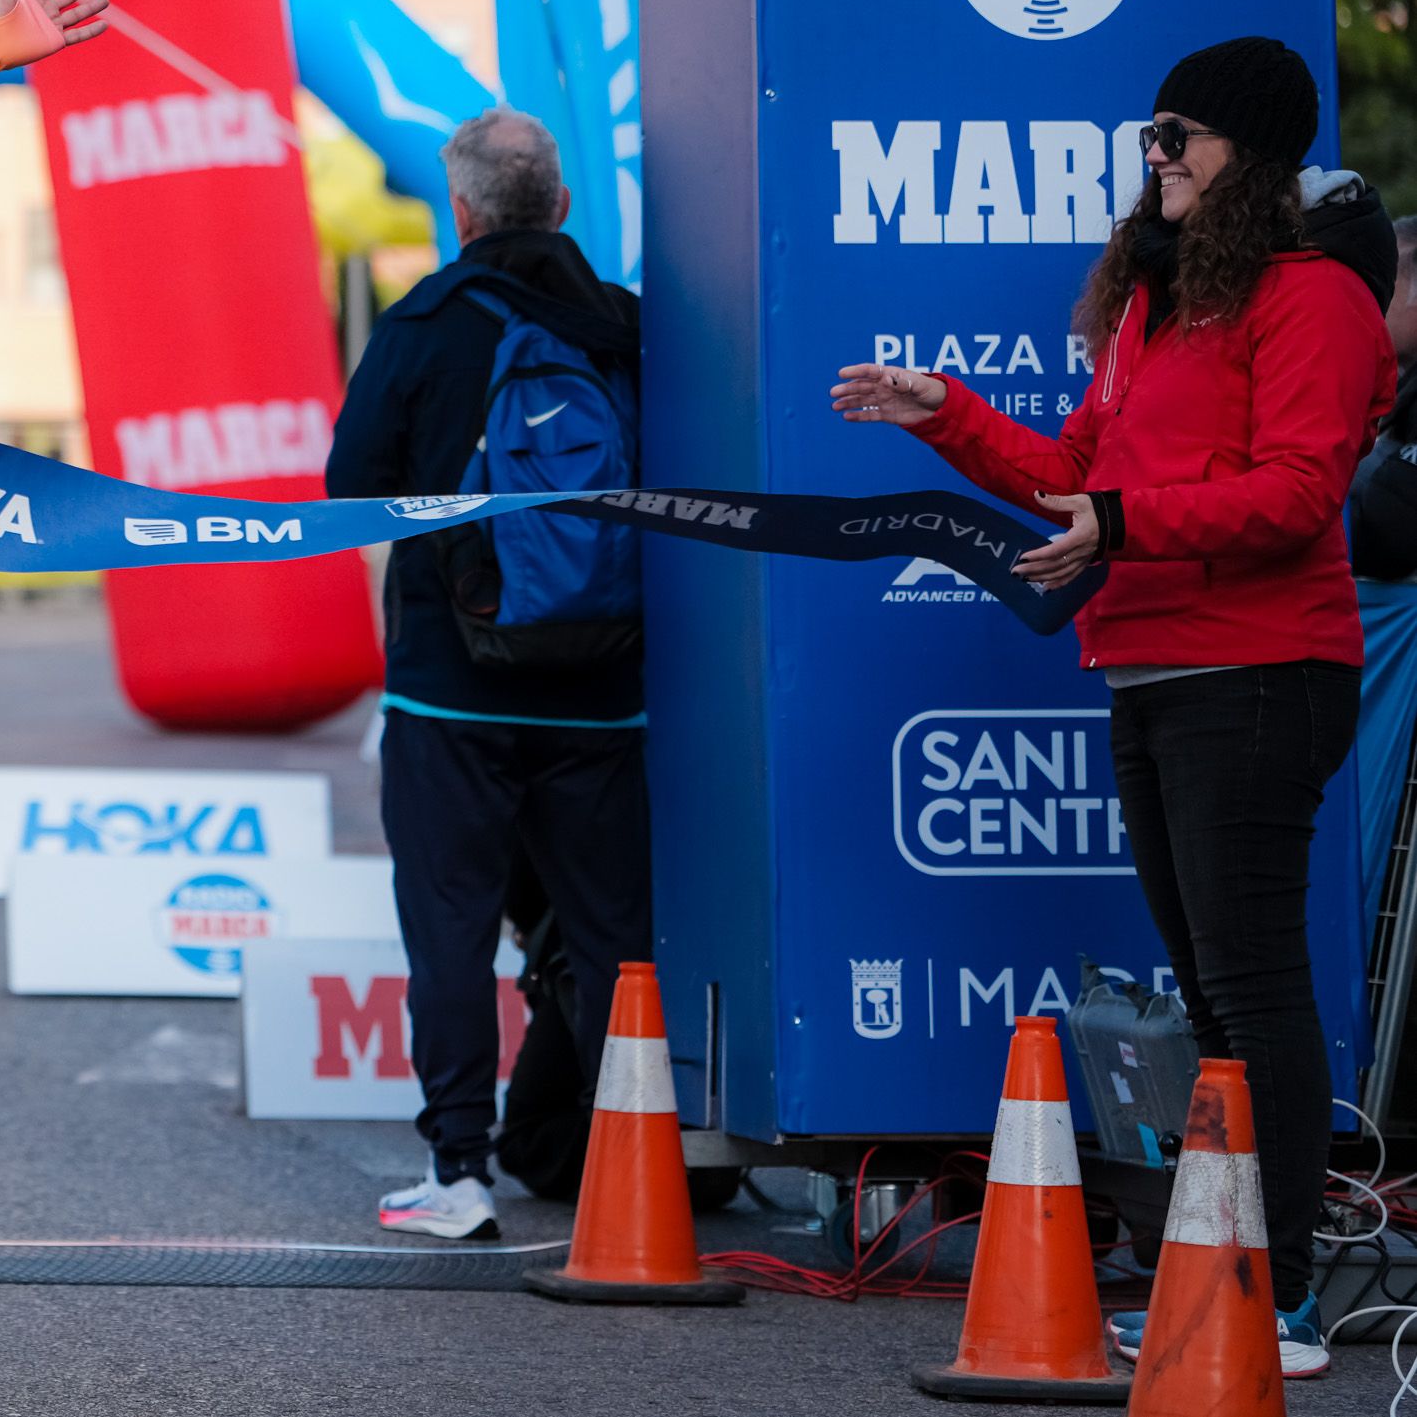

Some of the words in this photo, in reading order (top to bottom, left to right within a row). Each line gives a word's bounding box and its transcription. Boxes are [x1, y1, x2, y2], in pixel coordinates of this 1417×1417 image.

[62, 89, 289, 188] MARCA
[875, 334, 1044, 375] PLAZA
[197, 517, 302, 543] BM
[839, 513, 1006, 558] MADRID
[881, 590, 975, 602] ADVANCED
[922, 731, 1086, 791] SANI
[21, 801, 268, 855] HOKA
[917, 798, 1126, 855] CENT
